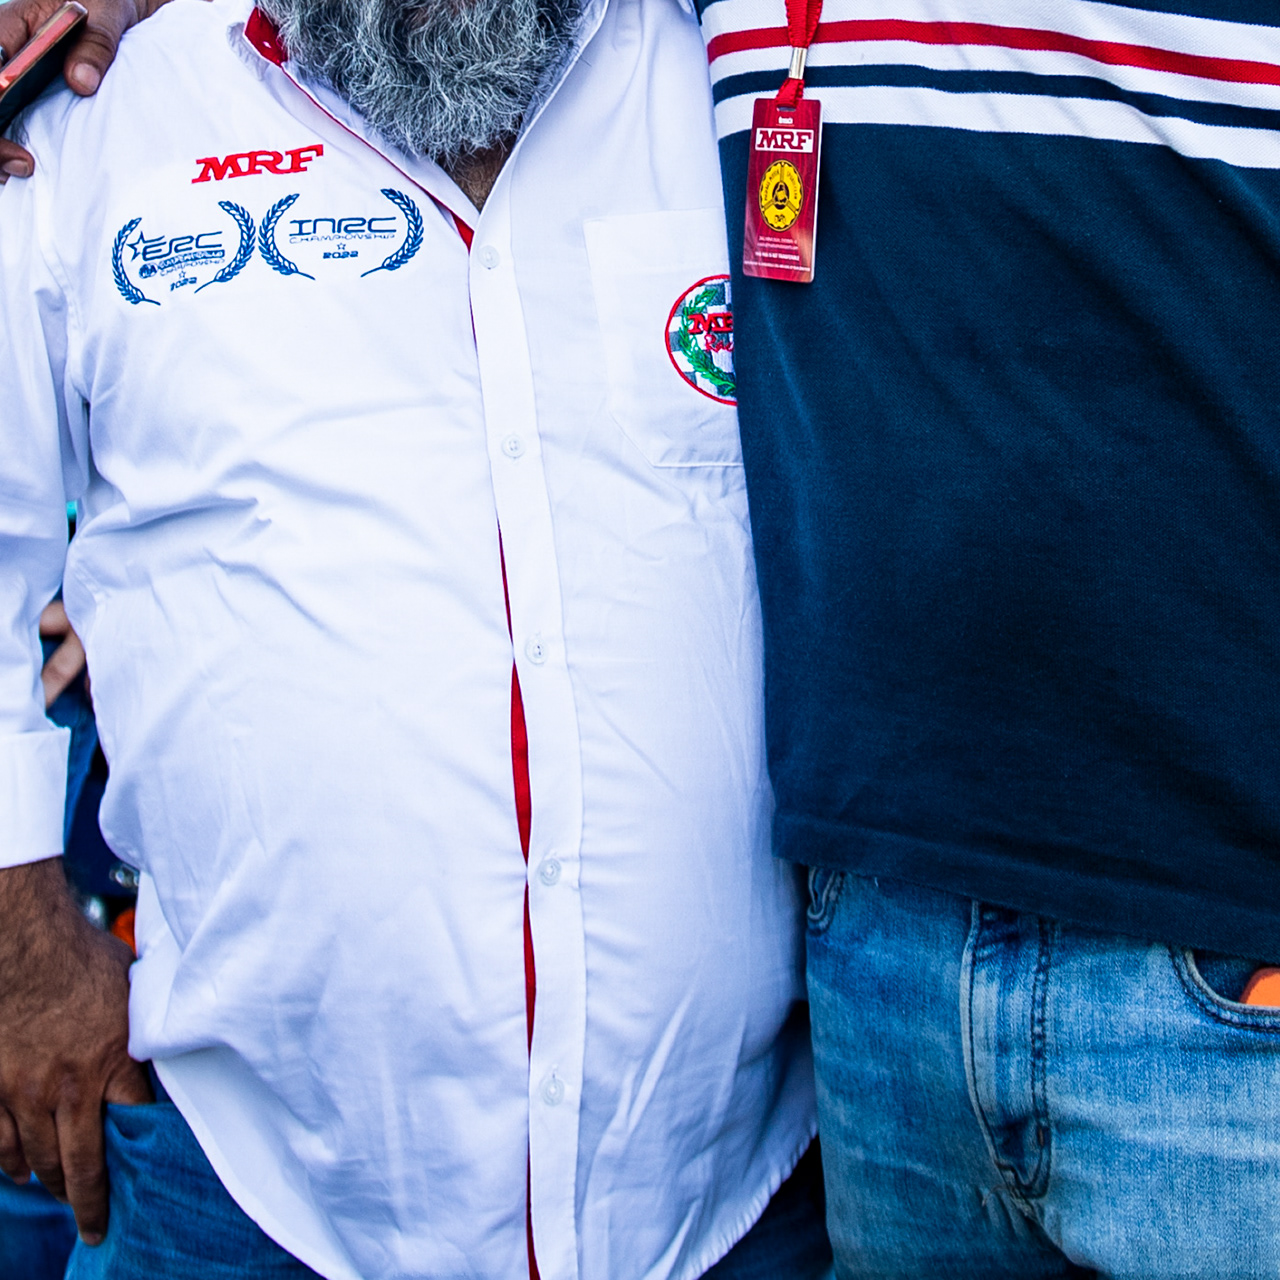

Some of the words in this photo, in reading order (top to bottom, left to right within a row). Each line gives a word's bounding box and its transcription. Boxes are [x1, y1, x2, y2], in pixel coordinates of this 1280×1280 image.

[757, 130, 812, 150] MRF
[191, 144, 324, 184] MRF
[289, 217, 397, 236] INRC
[140, 231, 223, 262] ERC
[322, 250, 359, 259] 2022
